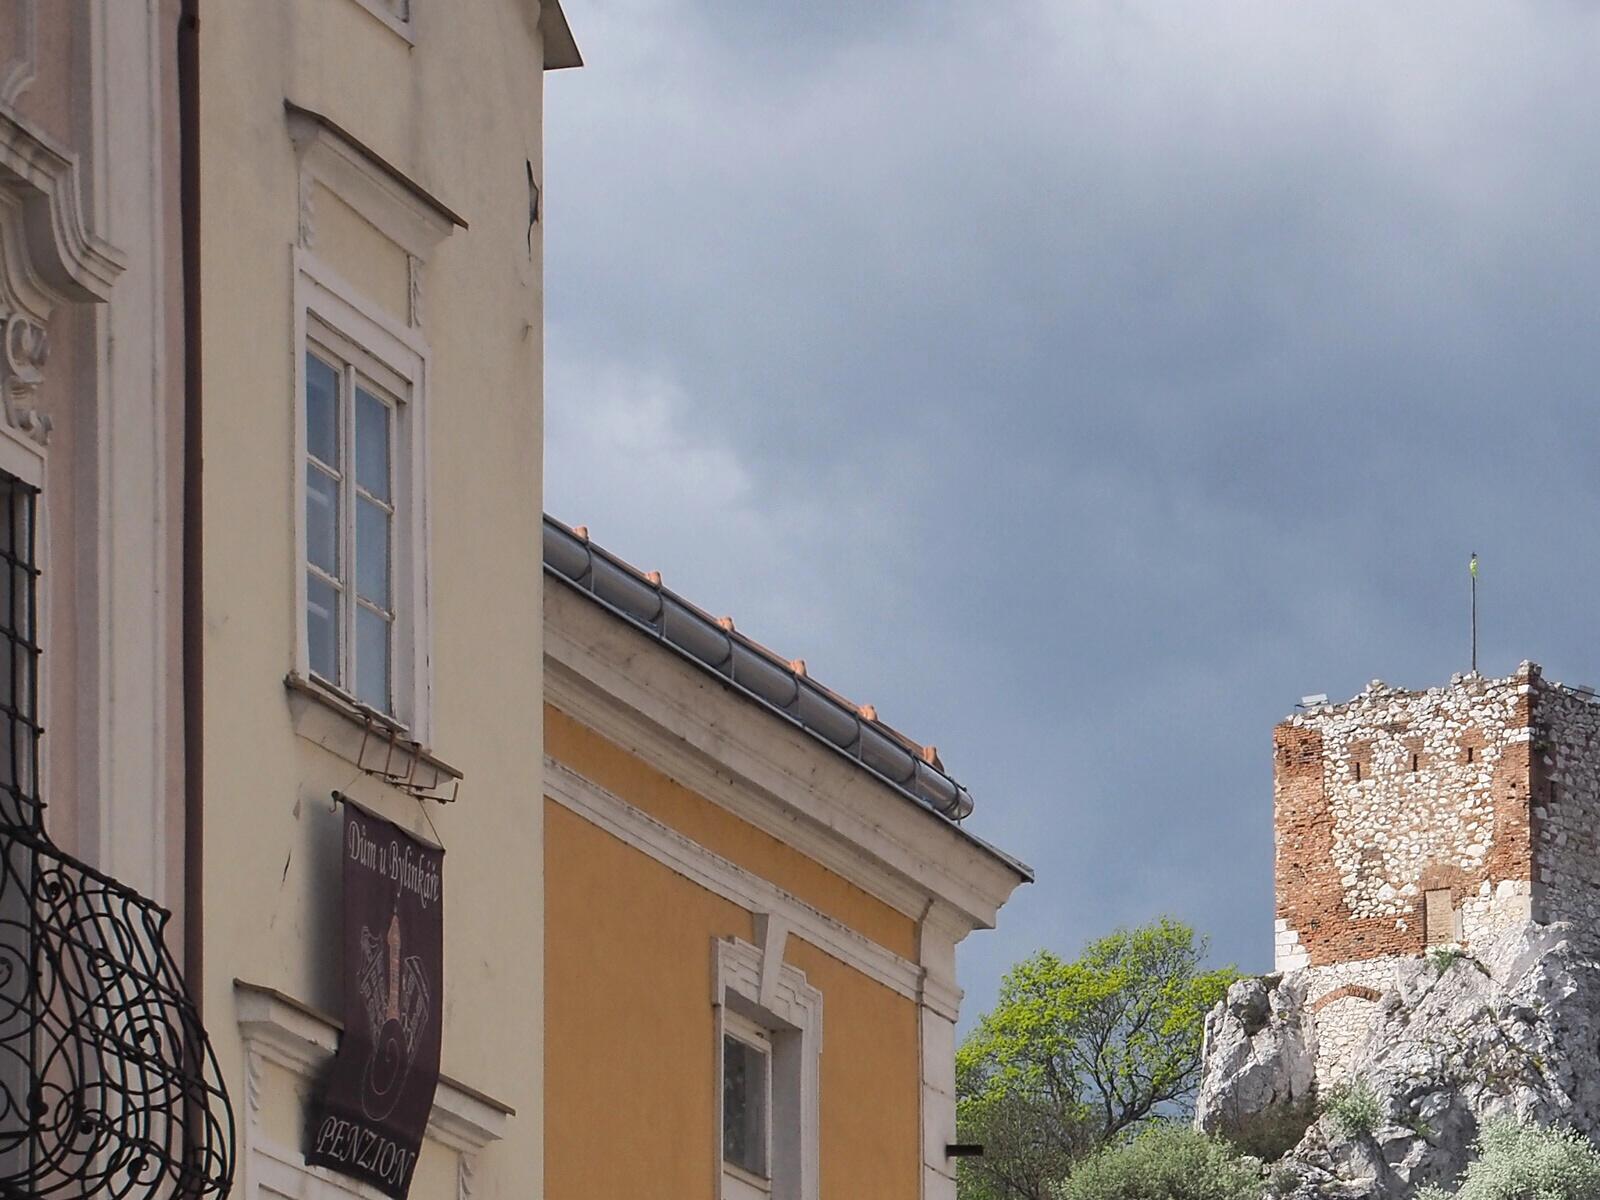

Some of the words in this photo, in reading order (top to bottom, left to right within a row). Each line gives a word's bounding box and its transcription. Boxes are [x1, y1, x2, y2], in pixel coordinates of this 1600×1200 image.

[348, 820, 377, 871] Dům
[379, 847, 387, 876] u
[316, 1116, 415, 1187] PENZION
